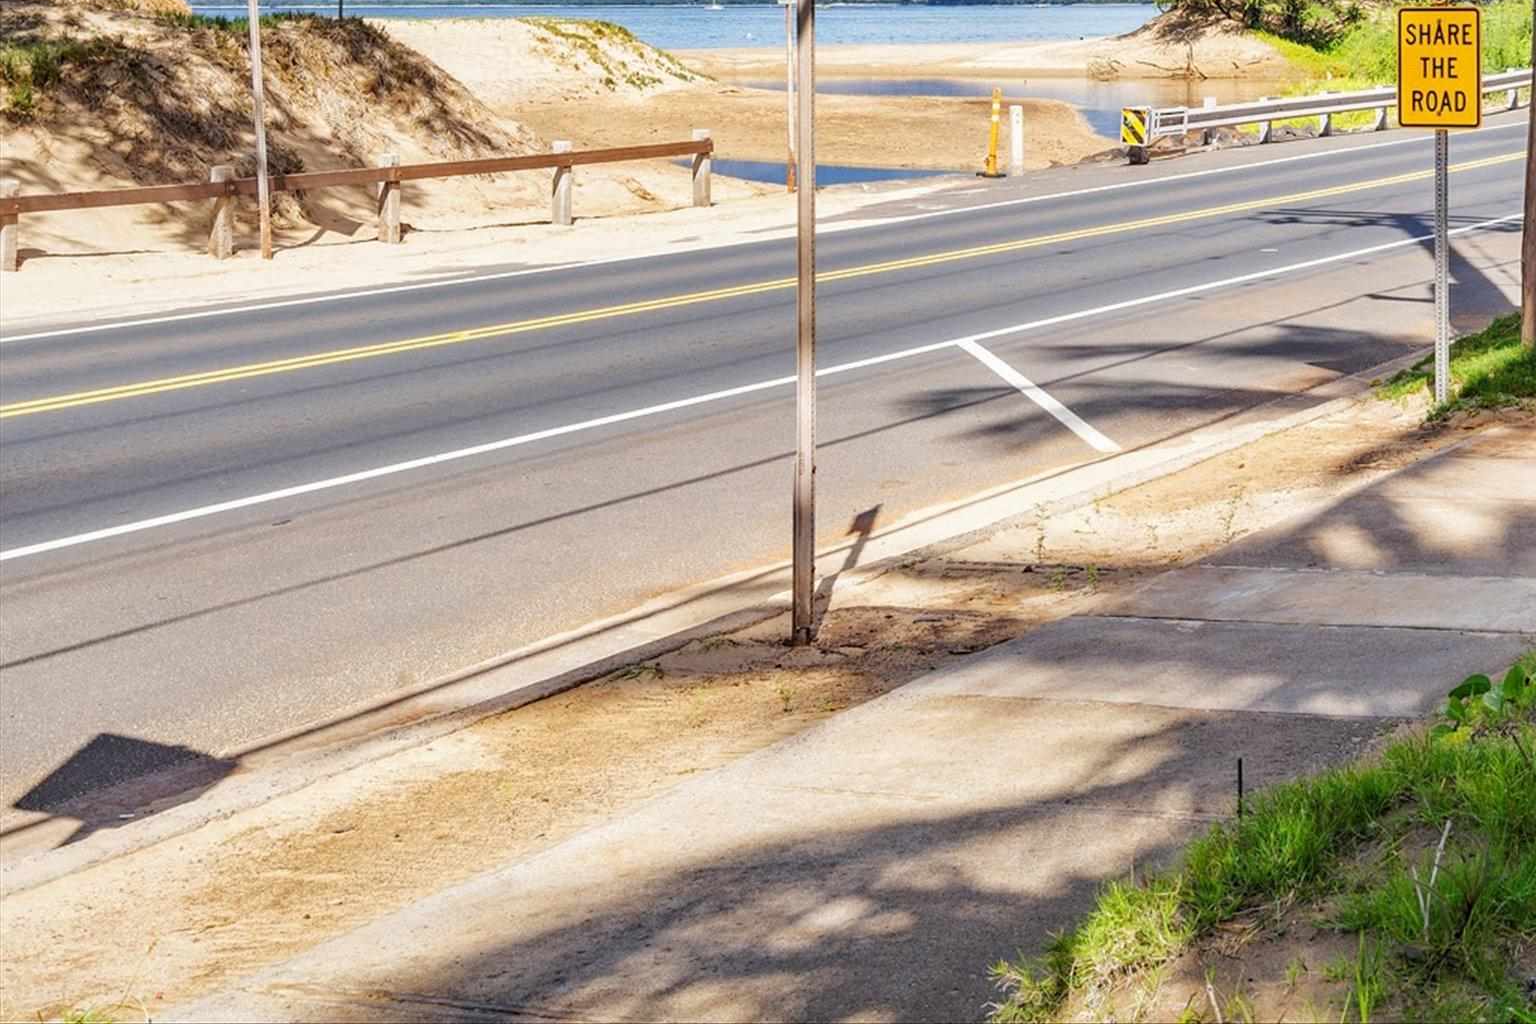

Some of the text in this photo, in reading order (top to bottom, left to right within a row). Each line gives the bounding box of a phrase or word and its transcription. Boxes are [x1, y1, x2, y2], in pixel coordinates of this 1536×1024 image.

[1406, 23, 1472, 45] SHARE
[1421, 58, 1458, 78] THE
[1412, 91, 1466, 112] ROAD
